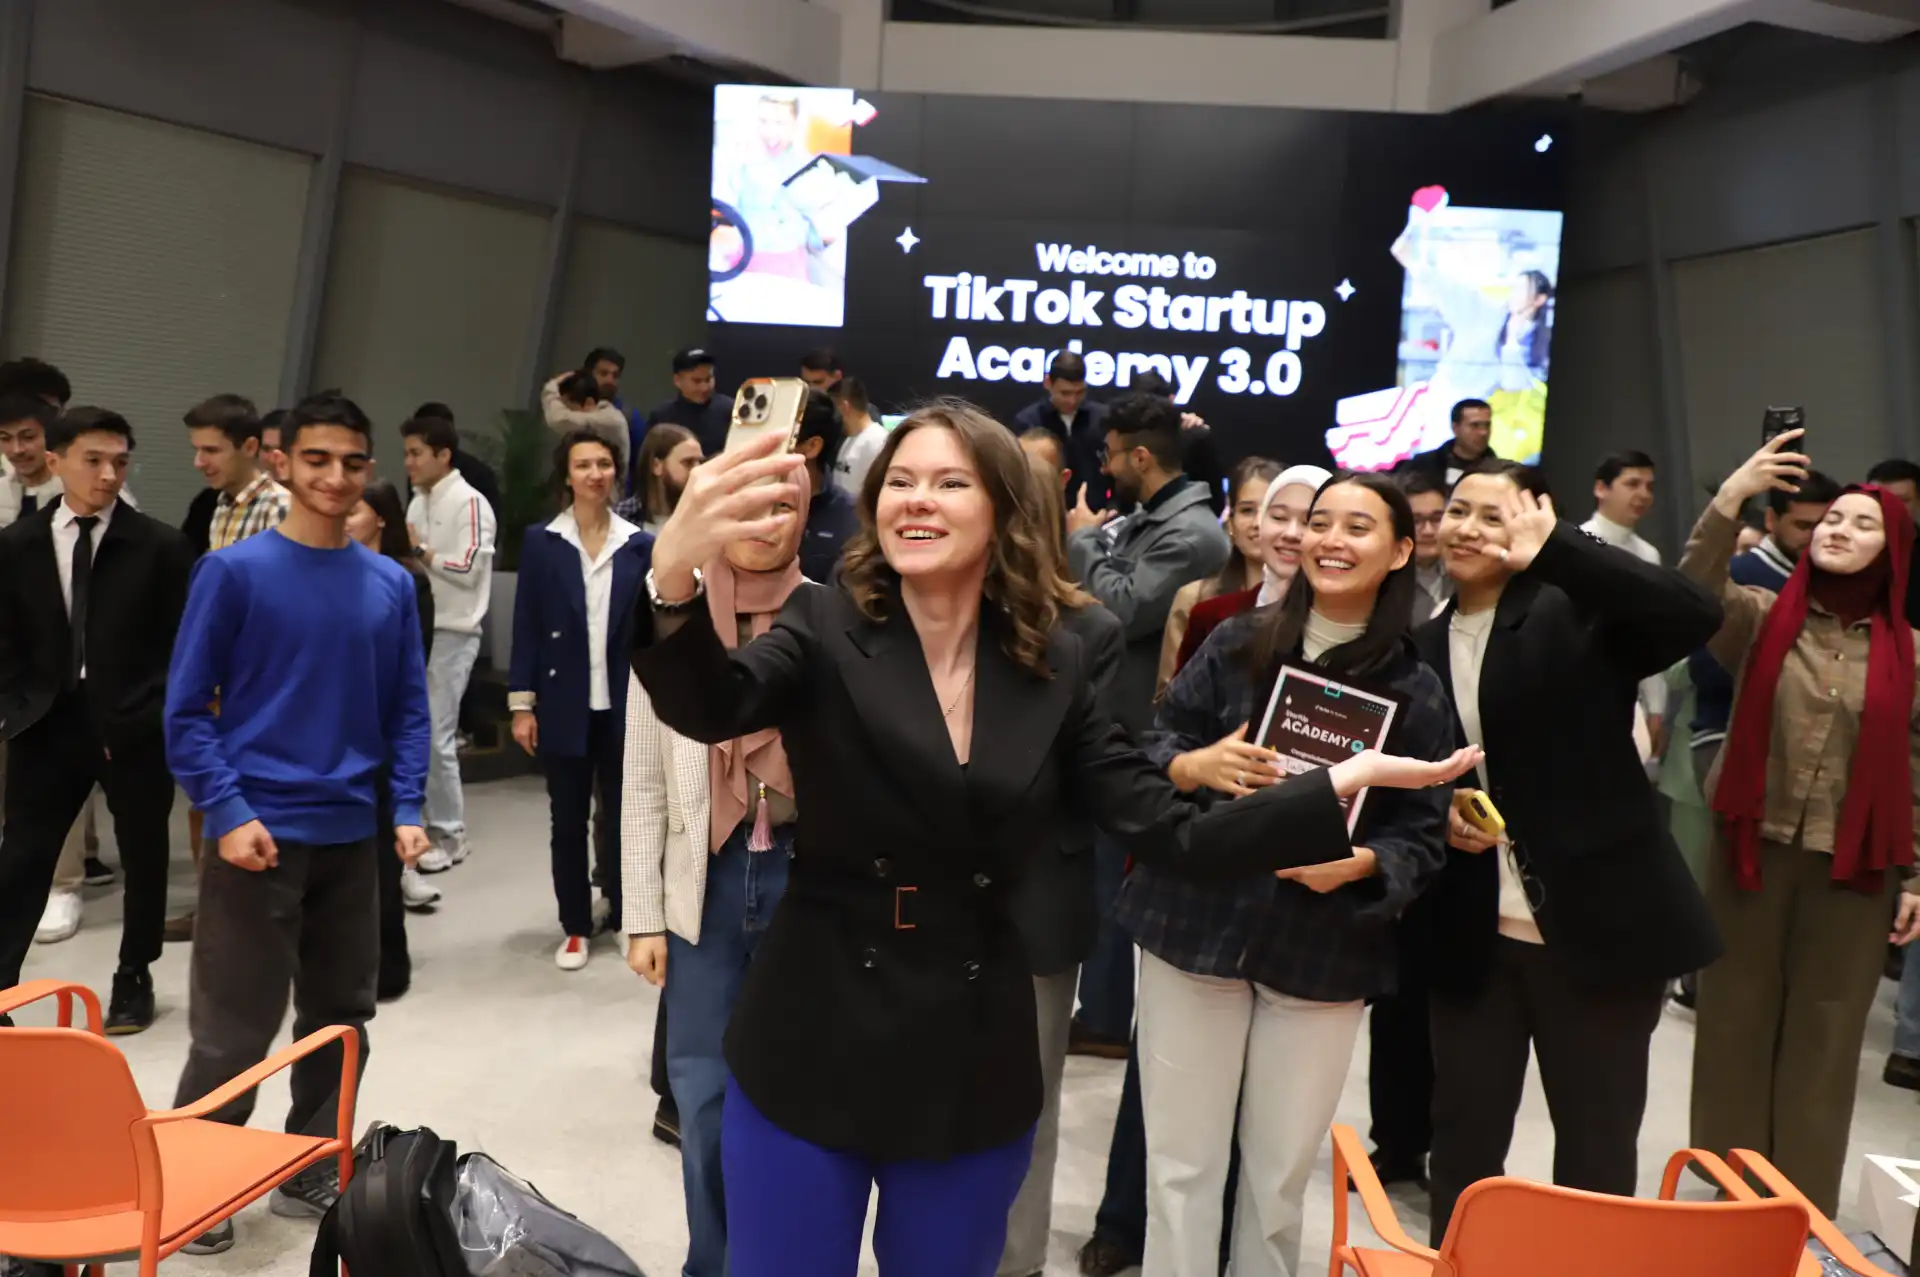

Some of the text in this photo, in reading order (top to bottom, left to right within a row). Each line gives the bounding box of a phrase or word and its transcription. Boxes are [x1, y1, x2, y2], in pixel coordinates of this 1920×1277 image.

[1036, 243, 1217, 279] Welcome to
[924, 271, 1326, 351] TikTok Startup
[1218, 346, 1303, 396] 3.0
[1281, 717, 1351, 748] ACADEMY
